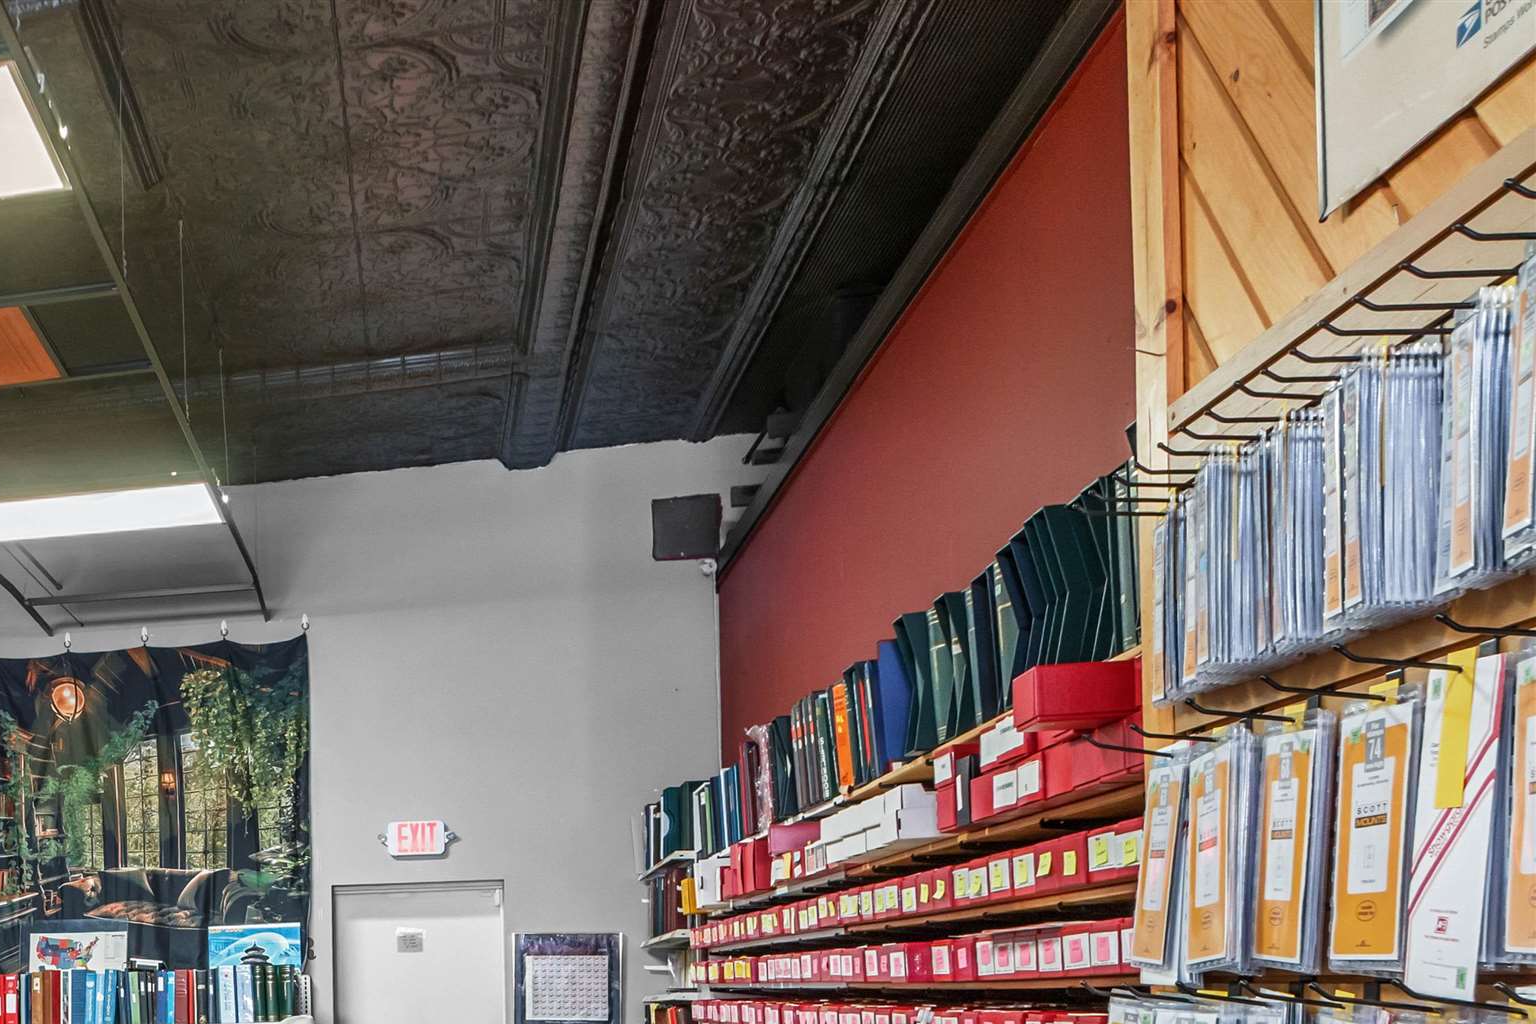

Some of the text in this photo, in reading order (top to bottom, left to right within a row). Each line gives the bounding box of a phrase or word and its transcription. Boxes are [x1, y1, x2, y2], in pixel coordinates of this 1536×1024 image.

[1367, 737, 1384, 761] 74
[1357, 802, 1388, 816] SCOTT
[397, 823, 437, 853] EXIT
